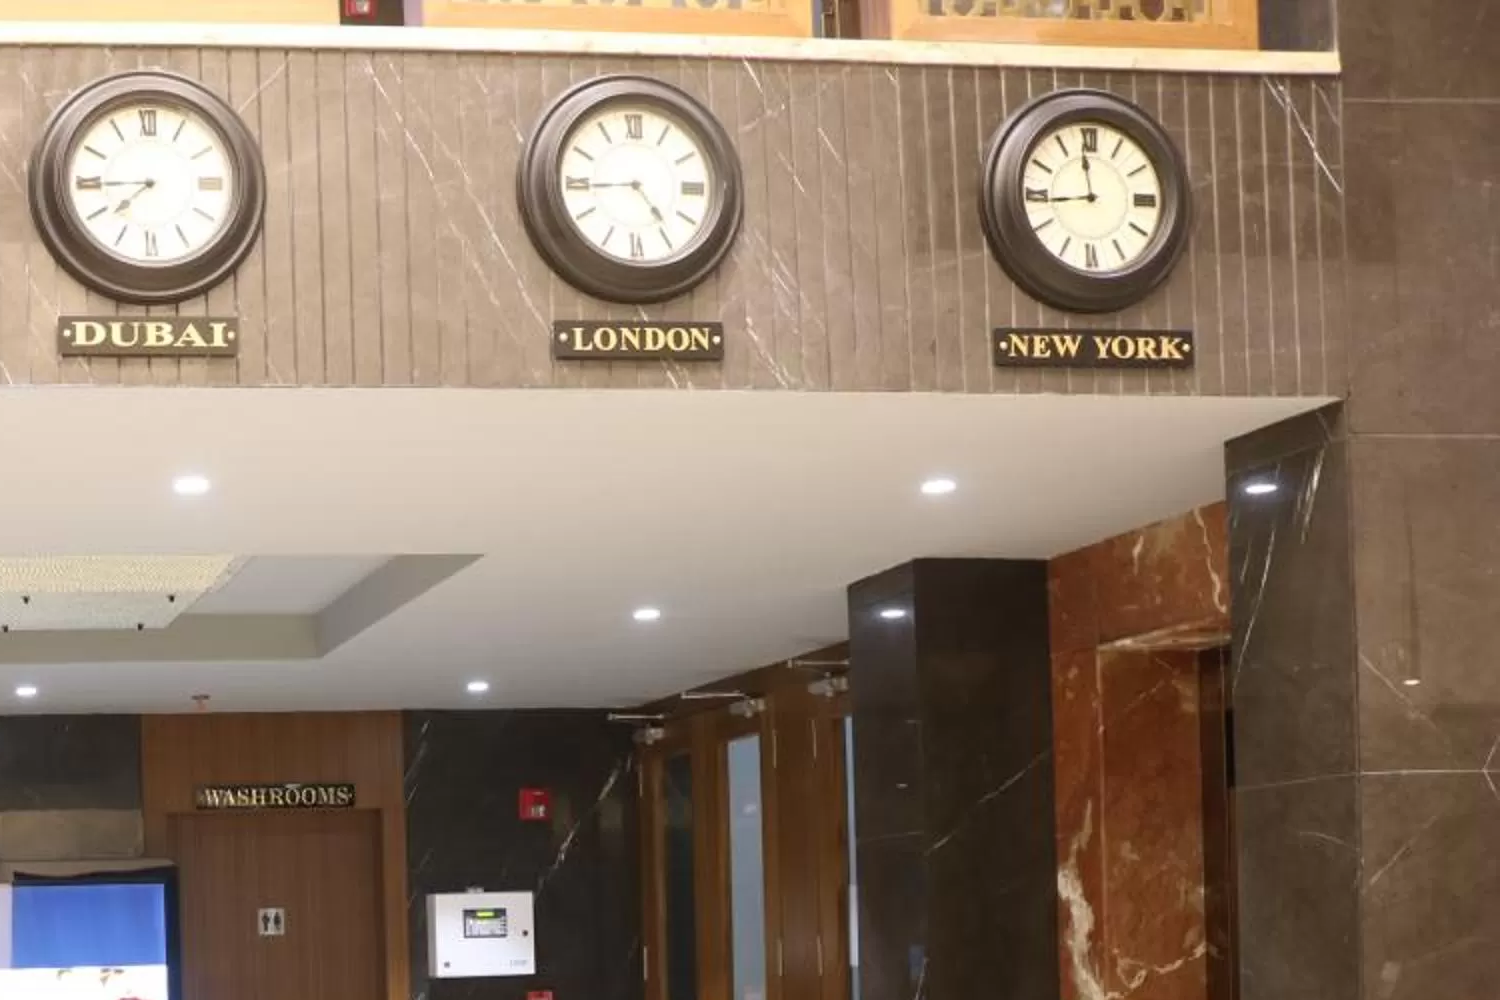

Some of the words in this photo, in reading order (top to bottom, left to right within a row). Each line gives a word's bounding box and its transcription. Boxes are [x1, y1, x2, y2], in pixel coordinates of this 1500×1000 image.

[71, 321, 229, 348] DUBAI
[572, 326, 710, 352] LONDON
[1007, 333, 1083, 357] NEW
[1092, 335, 1184, 360] YORK
[203, 786, 350, 807] WASHROOMS
